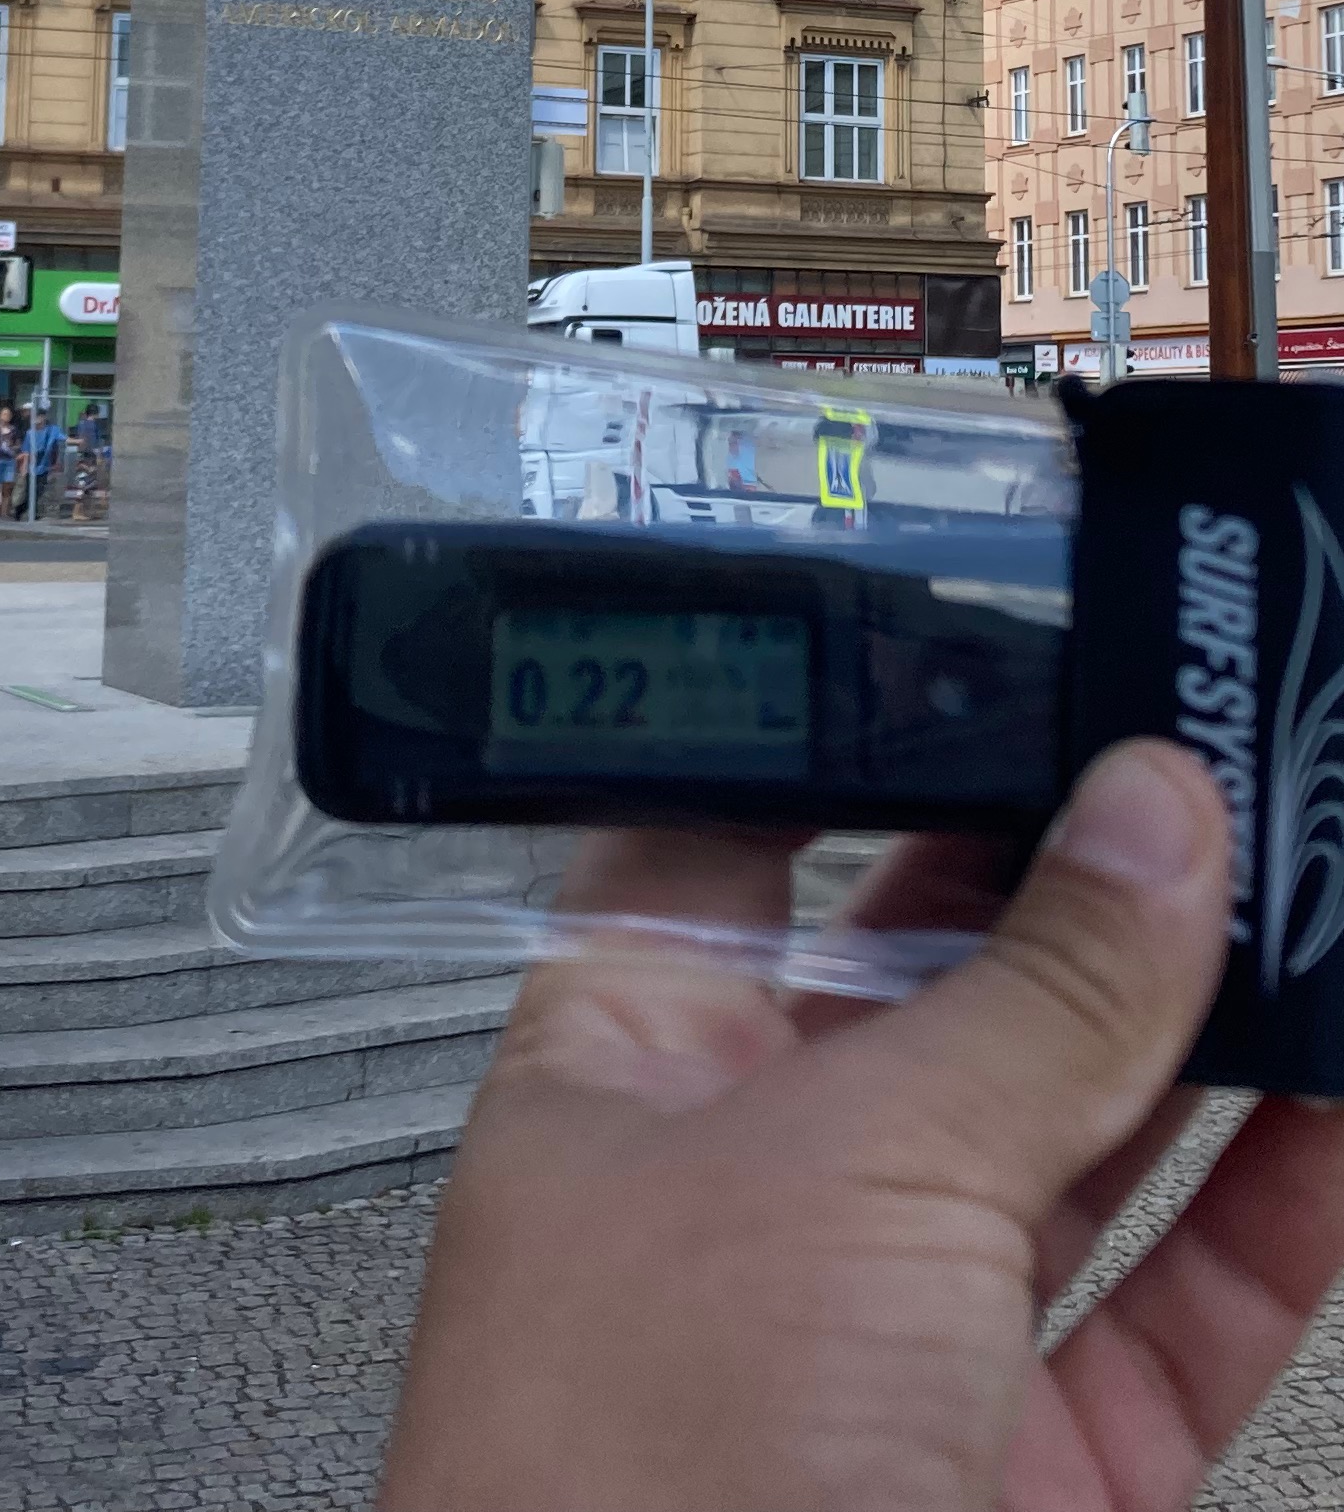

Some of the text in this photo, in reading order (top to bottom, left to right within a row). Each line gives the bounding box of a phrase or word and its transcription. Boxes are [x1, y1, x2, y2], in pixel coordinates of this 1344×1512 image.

[696, 296, 915, 330] OŽENÁ GALANTERIE
[1132, 345, 1184, 361] SPECIALITY
[1186, 344, 1194, 359] &
[1195, 343, 1210, 358] BIS
[508, 655, 649, 727] 0.22
